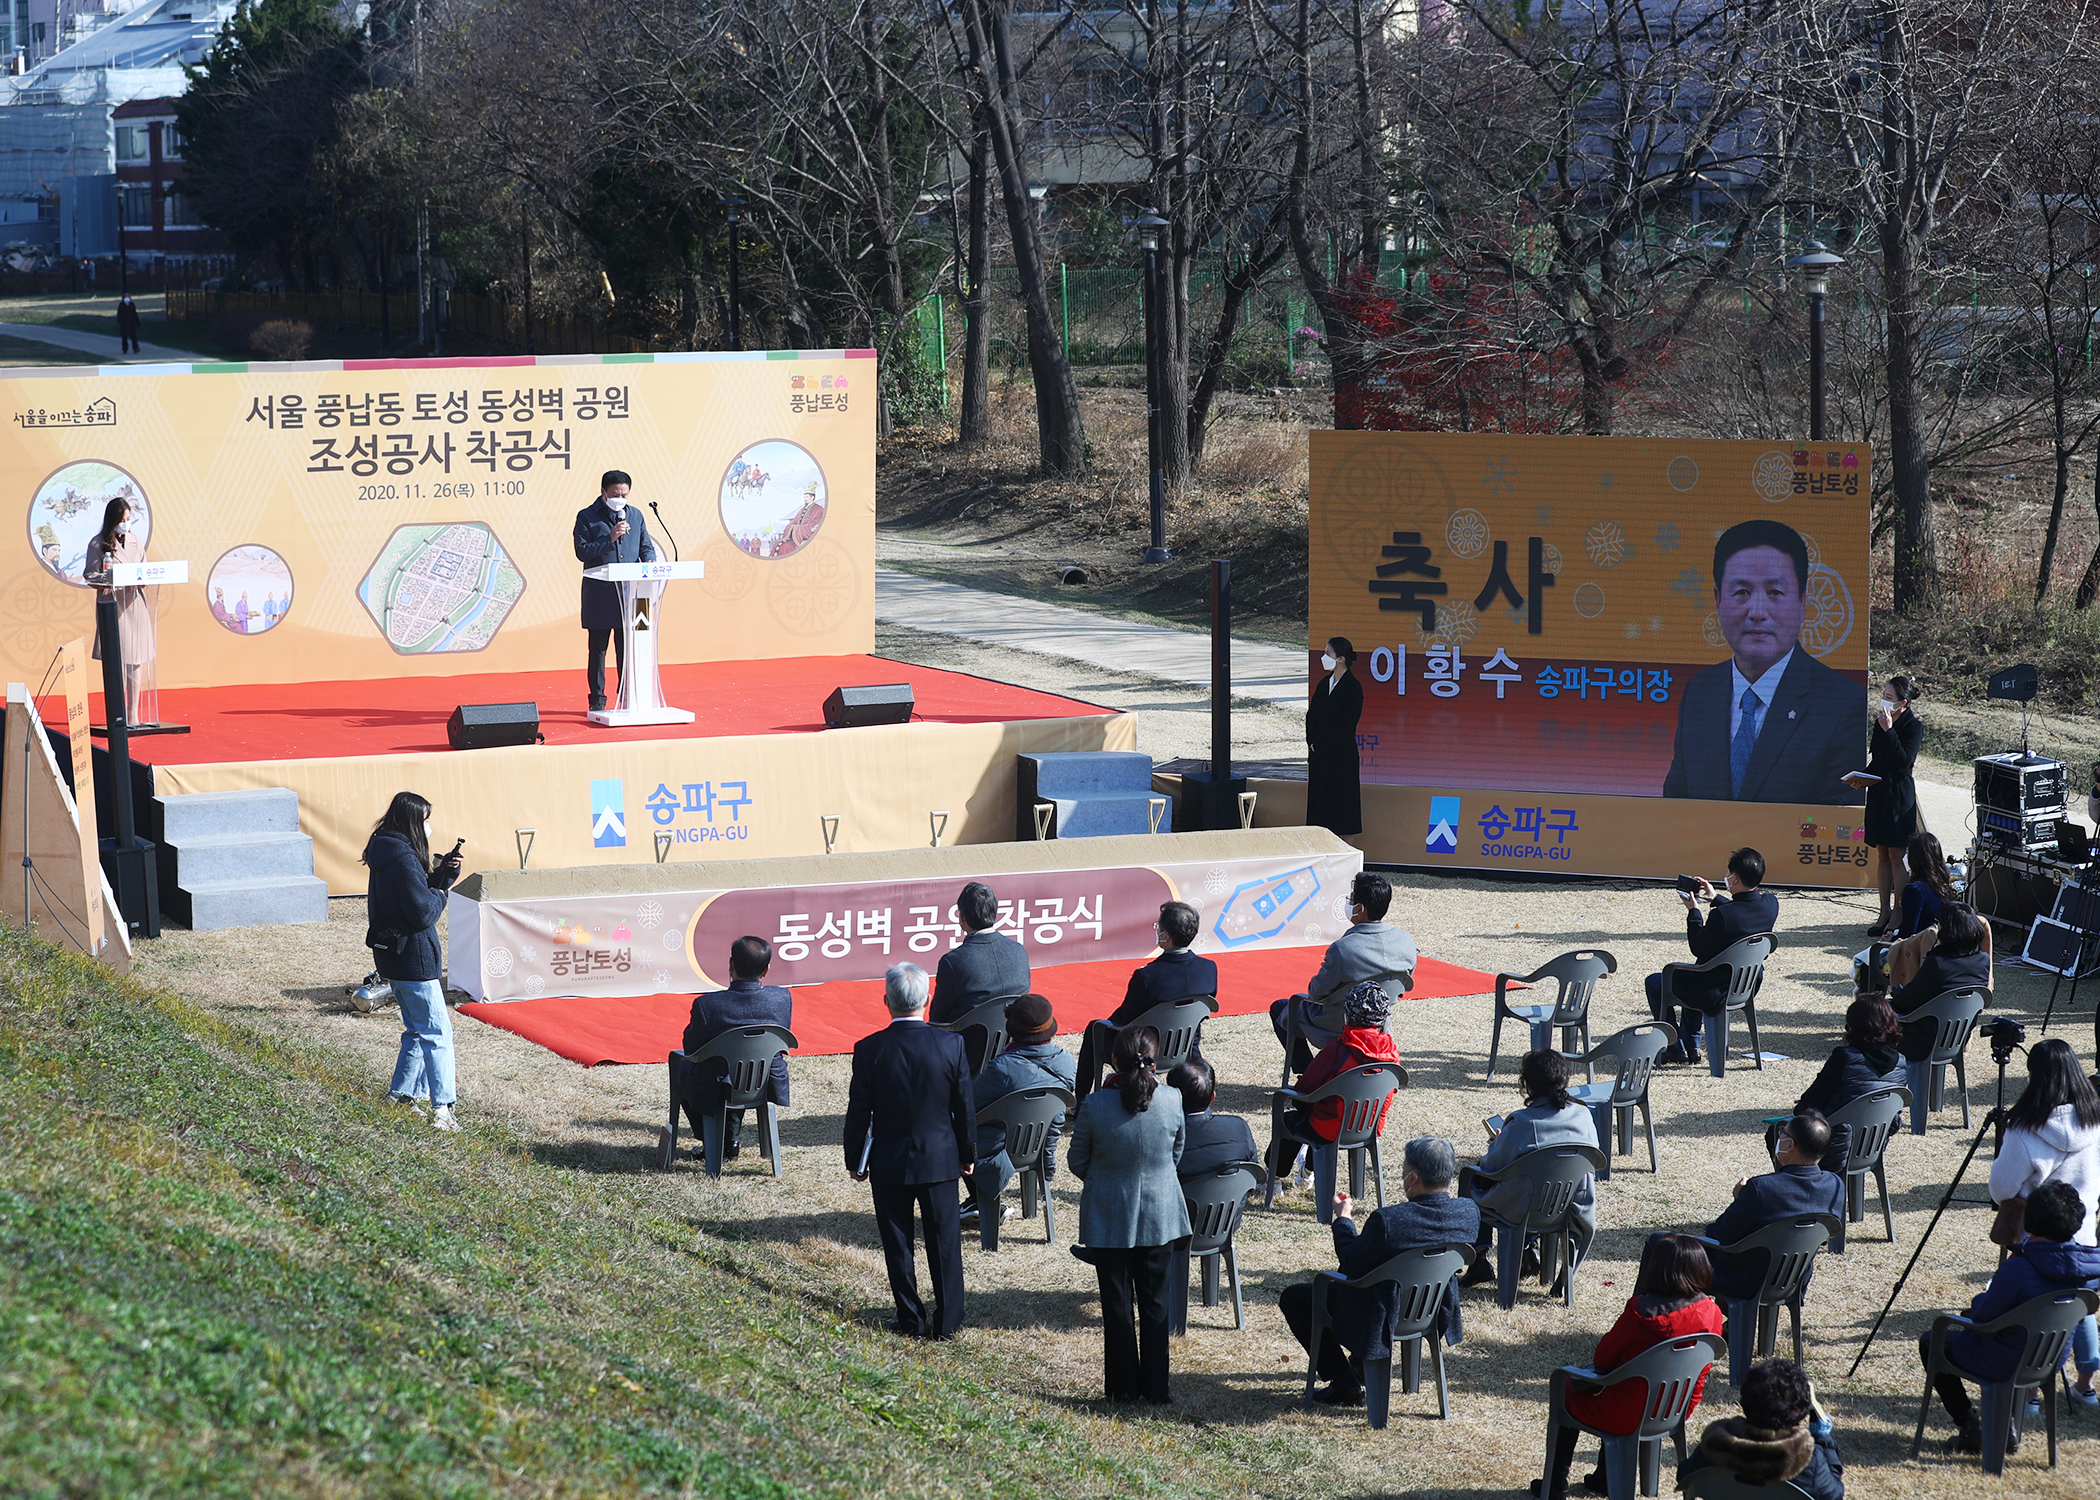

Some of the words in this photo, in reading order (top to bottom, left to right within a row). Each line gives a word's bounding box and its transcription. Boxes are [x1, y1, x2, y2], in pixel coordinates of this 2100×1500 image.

[84, 405, 111, 423] 송파
[245, 394, 306, 429] 서울
[314, 391, 405, 428] 풍납동
[412, 389, 468, 425] 토성
[478, 387, 564, 423] 동성벽
[572, 385, 630, 419] 공원
[790, 393, 848, 413] 풍납토성
[306, 431, 456, 477] 조성공사
[465, 428, 571, 472] 착공식
[358, 484, 399, 501] 2020.
[404, 483, 426, 500] 11.
[433, 481, 475, 499] 26(목)
[484, 480, 525, 497] 11:00
[1791, 472, 1858, 496] 풍납토성
[652, 565, 672, 575] 송파구
[1535, 665, 1673, 703] 송파구의장
[1355, 734, 1380, 751] 파구
[645, 781, 753, 825] 송파구
[1478, 804, 1579, 844] 송파구
[1480, 843, 1572, 861] SONGPA-GU
[1797, 844, 1869, 867] 풍납토성
[773, 906, 892, 962] 동성벽
[993, 894, 1104, 946] 착공식
[550, 947, 632, 976] 풍납토성
